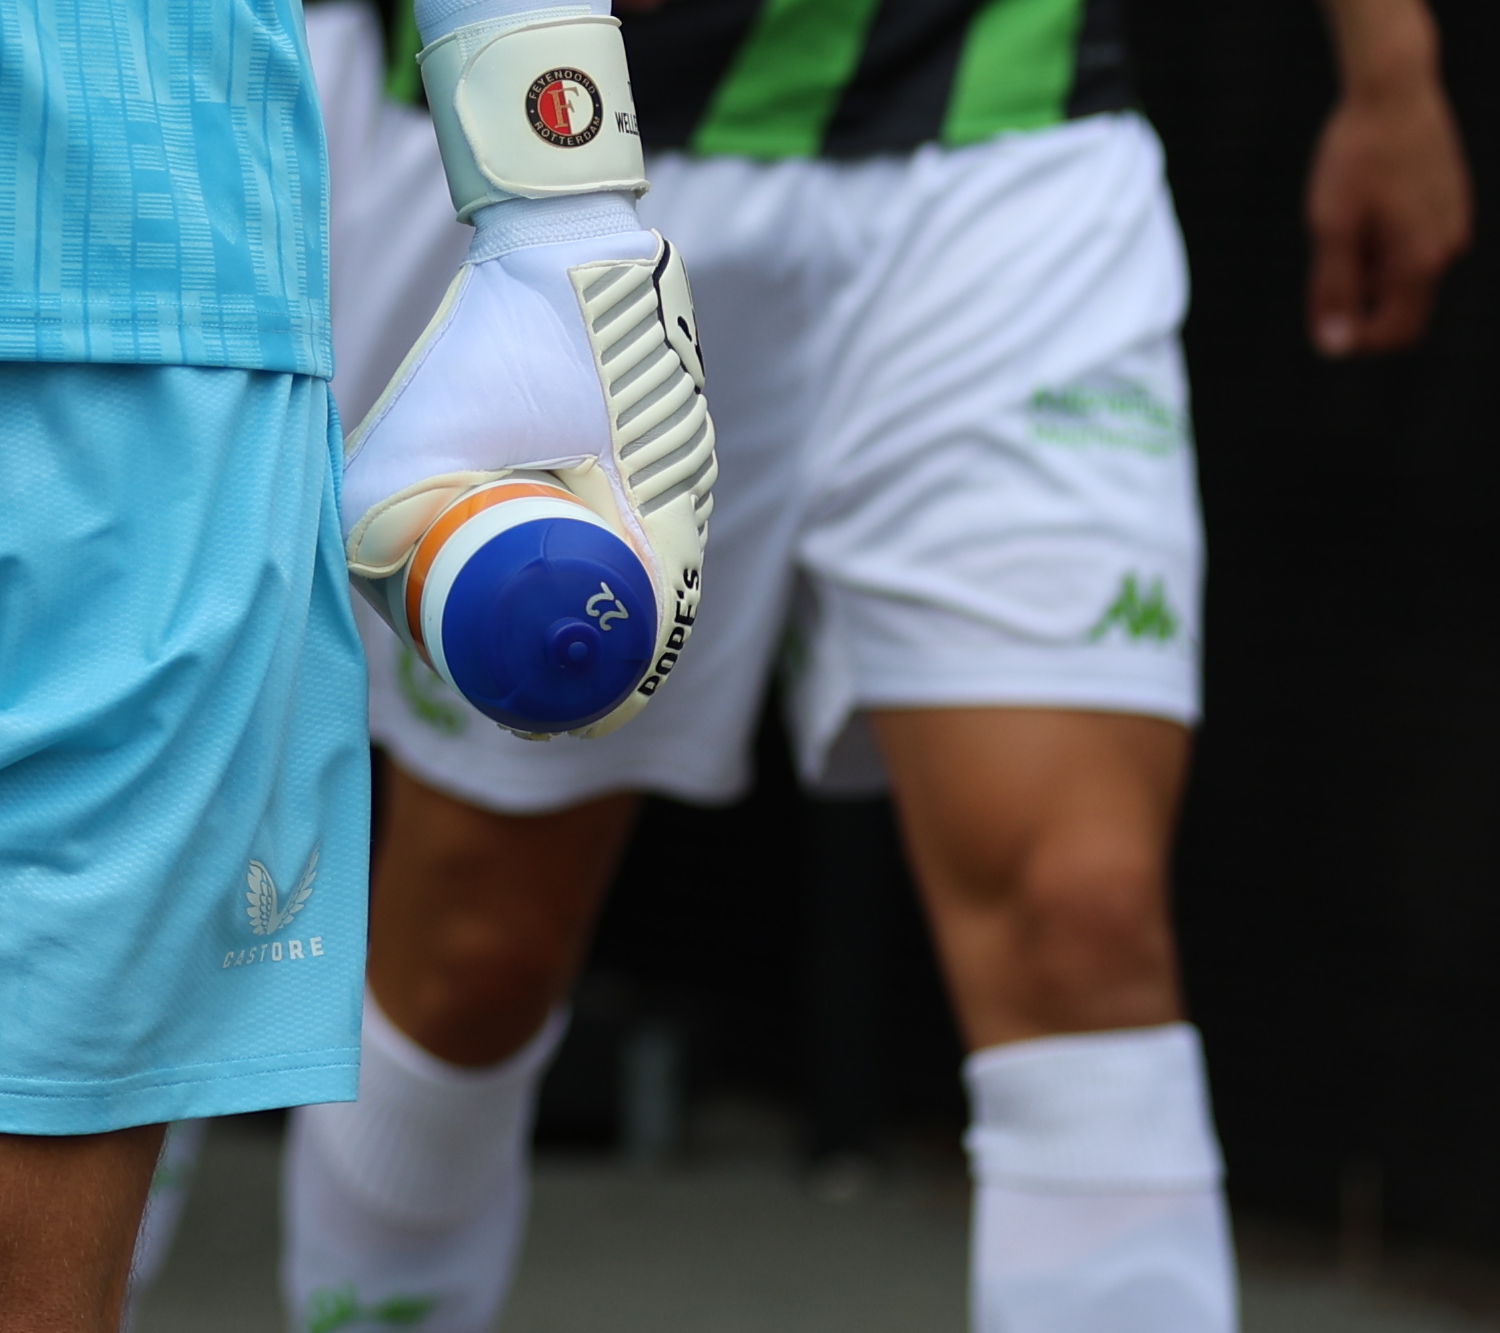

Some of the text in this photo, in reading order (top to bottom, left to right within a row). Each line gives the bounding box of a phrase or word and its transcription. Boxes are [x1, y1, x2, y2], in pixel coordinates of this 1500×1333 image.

[529, 70, 596, 100] FEYENOORD
[534, 116, 601, 146] ROTTERDAM
[586, 581, 630, 631] 22
[222, 936, 325, 969] CASTORE
